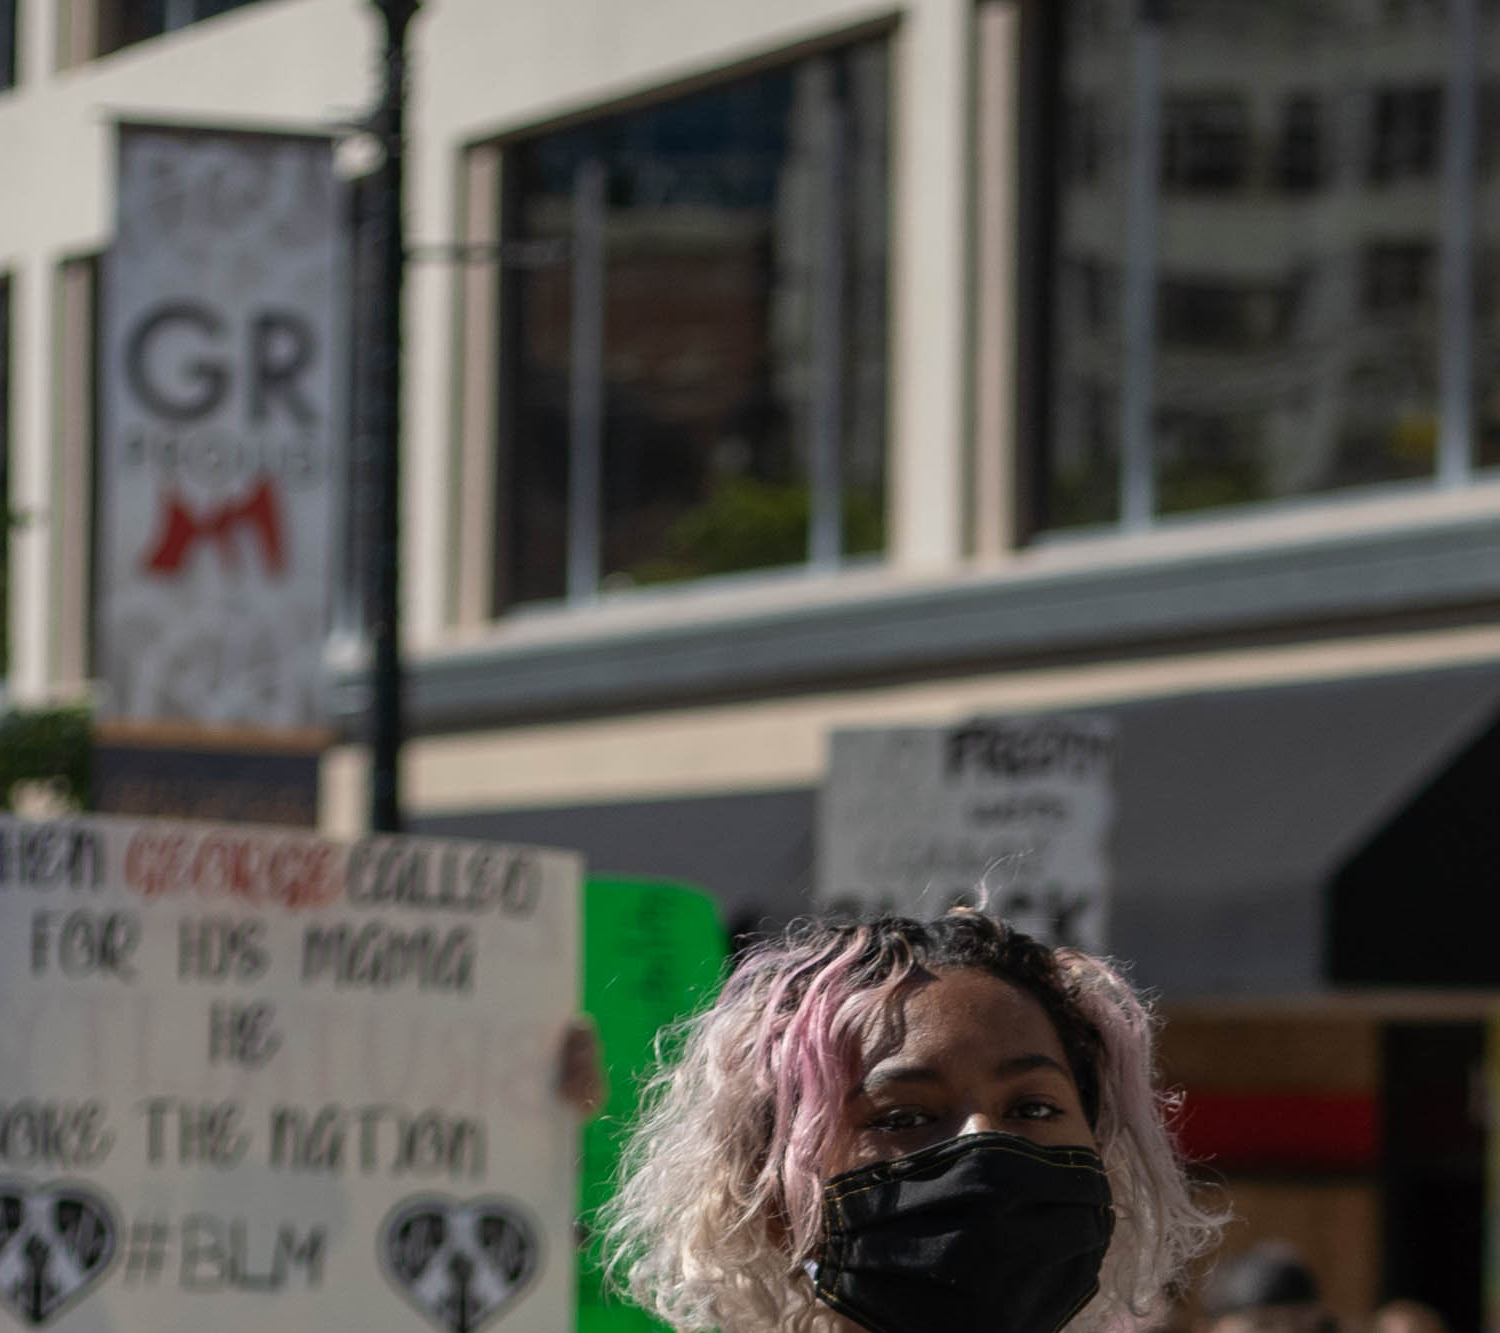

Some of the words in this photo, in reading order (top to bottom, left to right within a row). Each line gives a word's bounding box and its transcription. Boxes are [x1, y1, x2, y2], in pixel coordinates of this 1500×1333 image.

[122, 300, 319, 427] GR
[123, 824, 342, 908] GEORGE
[346, 840, 540, 916] CALLED
[30, 910, 140, 983] FOR
[302, 924, 478, 990] MAMA
[207, 1001, 280, 1067] HE
[144, 1099, 253, 1170] THE
[269, 1107, 488, 1180] NATION
[126, 1210, 325, 1292] #BLM
